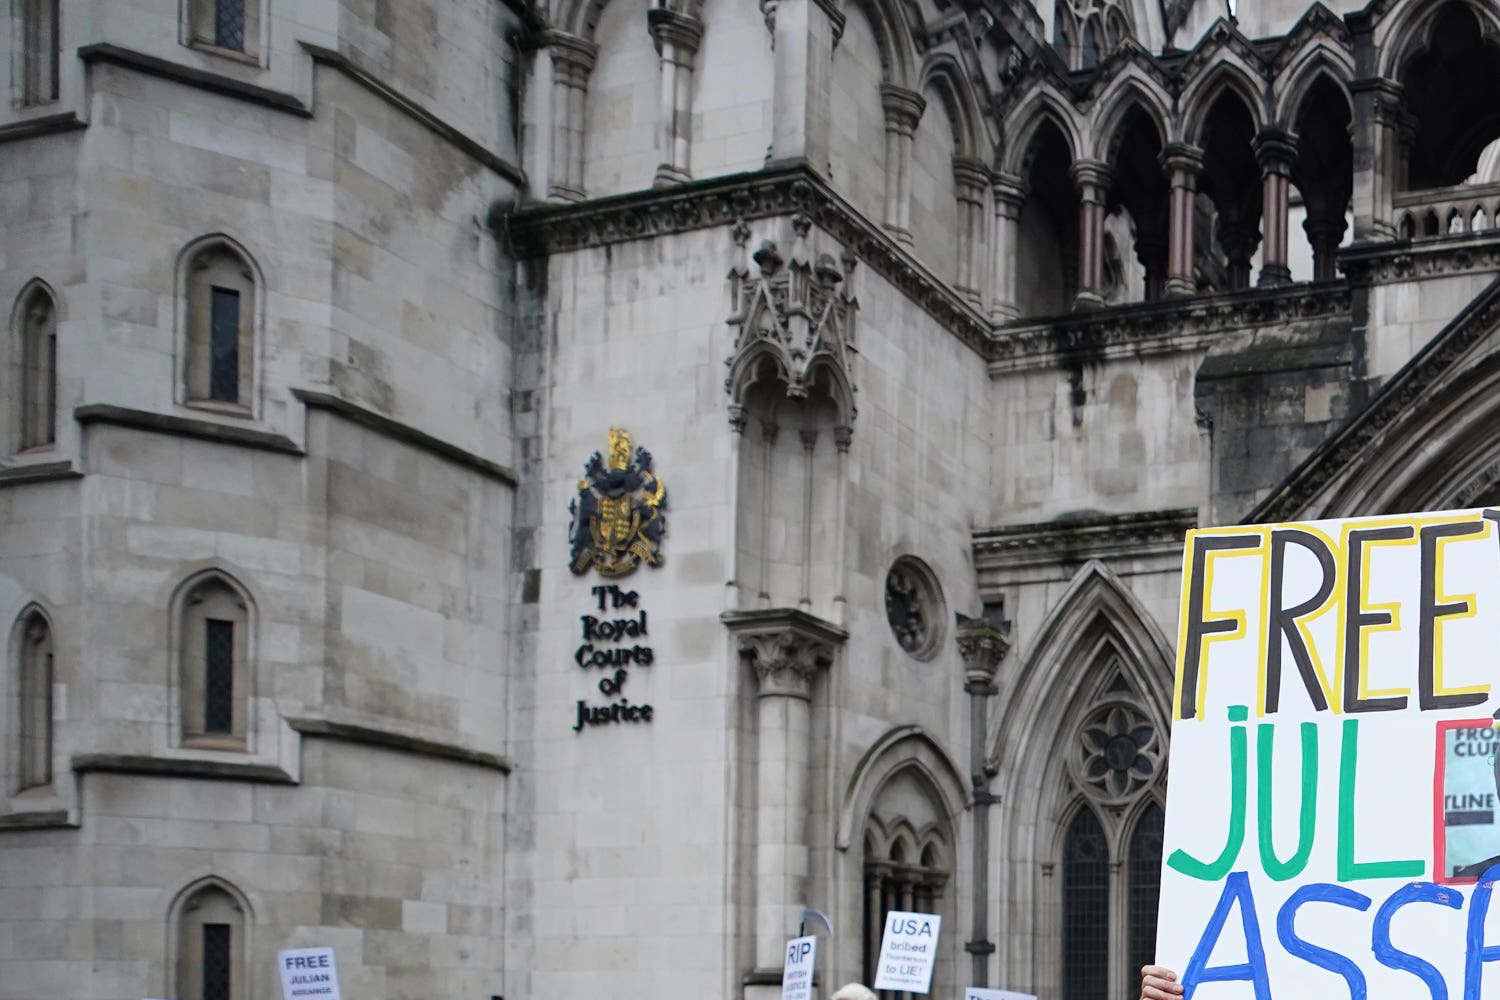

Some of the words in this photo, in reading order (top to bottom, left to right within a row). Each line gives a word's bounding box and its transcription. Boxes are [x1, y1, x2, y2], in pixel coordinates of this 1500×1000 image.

[591, 584, 640, 612] The
[580, 609, 648, 643] Royal
[574, 643, 654, 669] Courts
[597, 668, 628, 697] of
[572, 698, 654, 733] Justice
[892, 918, 932, 938] USA
[788, 942, 812, 965] RIP
[890, 940, 927, 953] bribed
[285, 955, 330, 970] FREE
[886, 965, 896, 974] to
[899, 965, 923, 977] LIE!
[290, 973, 330, 985] JULIAN
